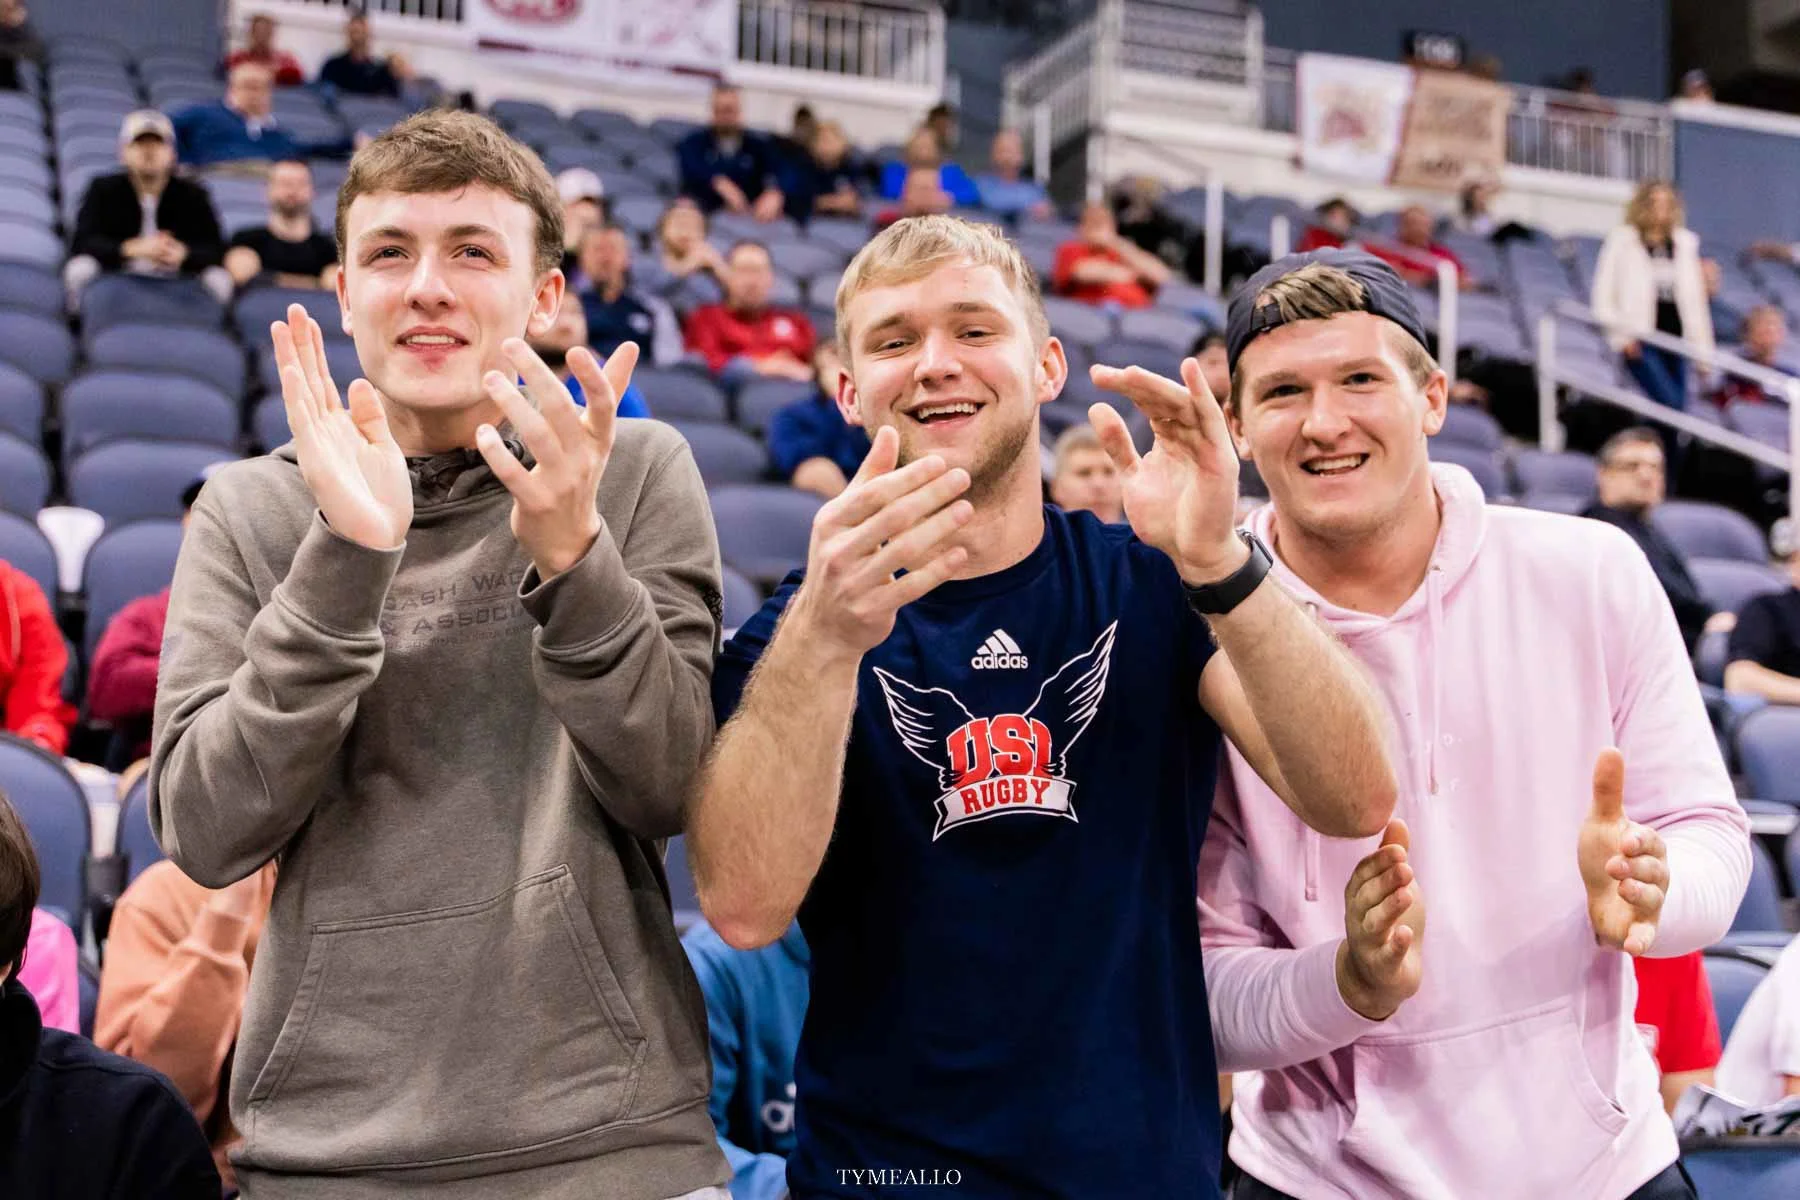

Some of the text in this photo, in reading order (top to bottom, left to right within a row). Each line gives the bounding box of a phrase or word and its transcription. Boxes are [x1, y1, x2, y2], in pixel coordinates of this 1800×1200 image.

[412, 604, 523, 635] ASSOCI
[971, 653, 1029, 669] adidas
[946, 713, 1053, 790] USI
[960, 778, 1051, 815] RUGBY
